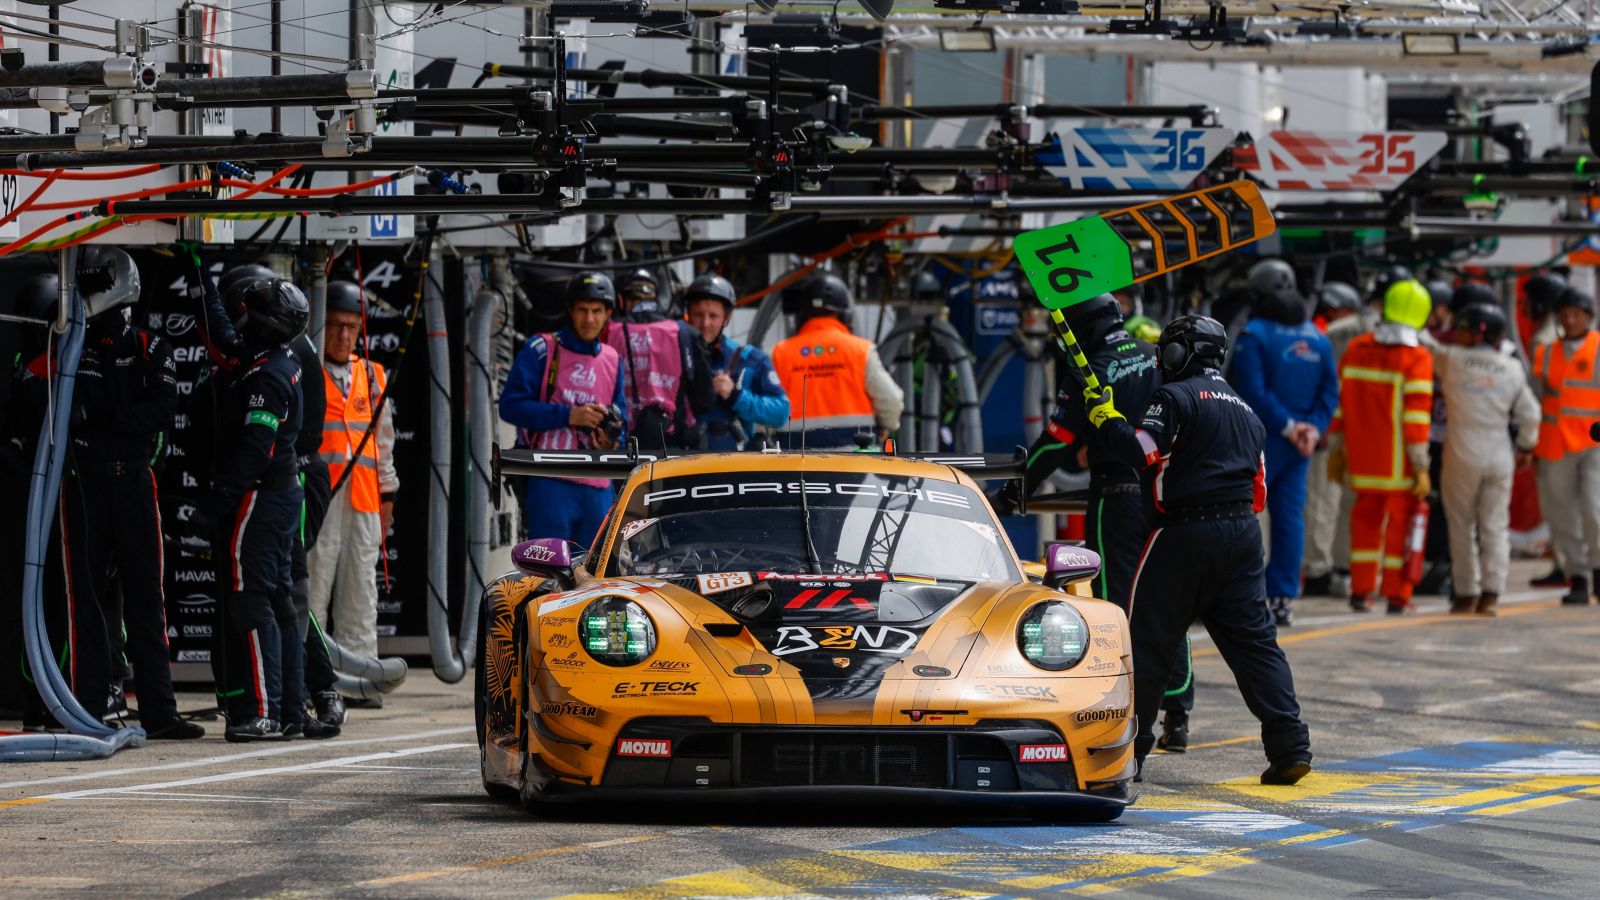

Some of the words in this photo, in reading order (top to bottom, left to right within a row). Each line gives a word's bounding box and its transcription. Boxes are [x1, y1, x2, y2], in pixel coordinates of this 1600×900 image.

[1152, 131, 1207, 171] 36
[1357, 135, 1416, 174] 35
[643, 481, 971, 509] PORSCHE
[706, 577, 745, 590] GT3
[764, 572, 883, 581] MOTUL
[619, 740, 669, 755] MOTUL
[1022, 746, 1067, 760] MOTUL
